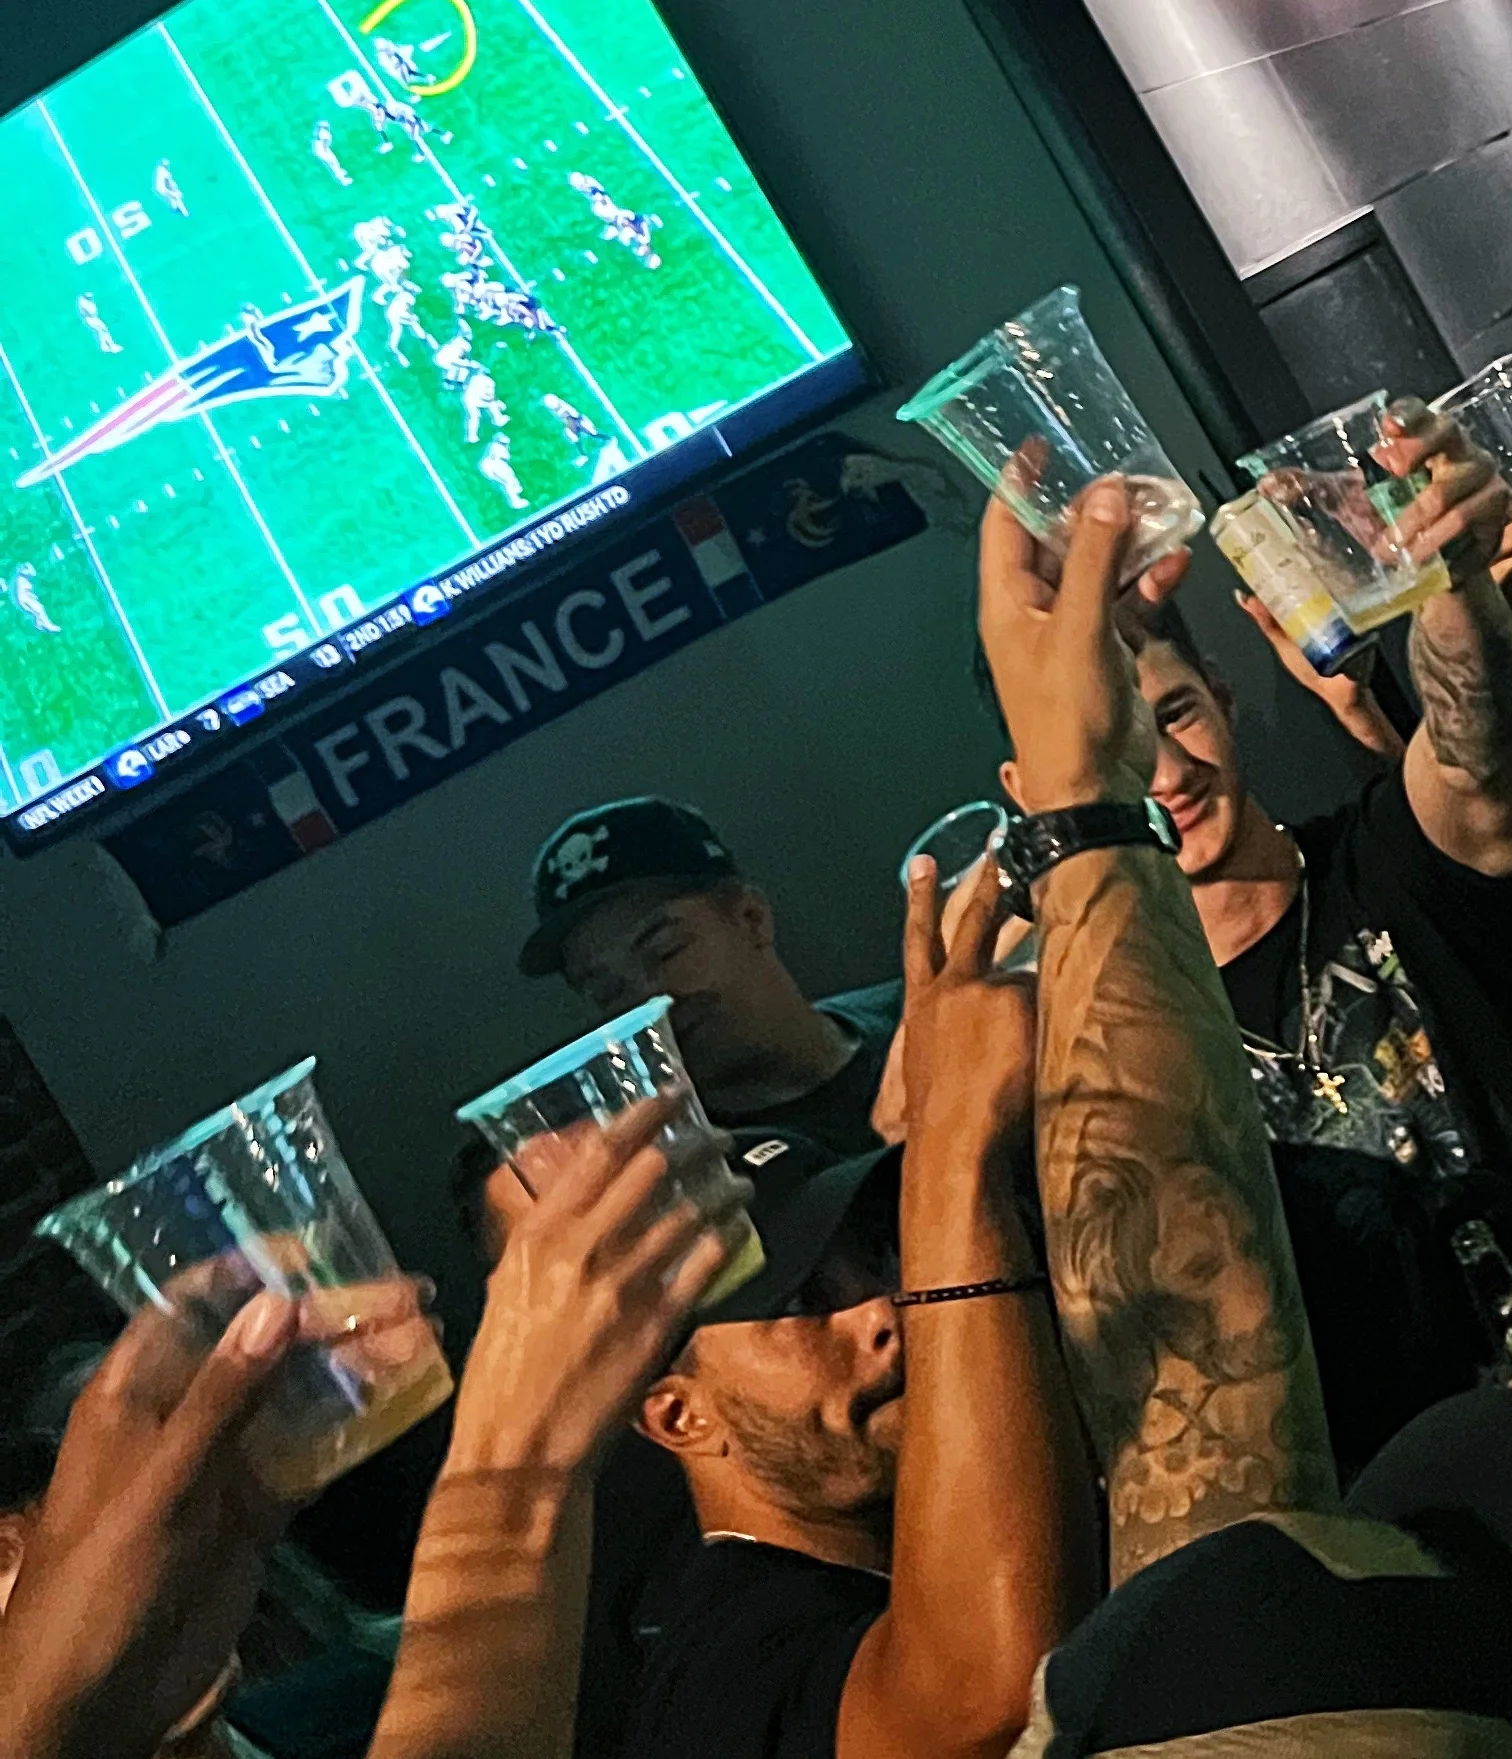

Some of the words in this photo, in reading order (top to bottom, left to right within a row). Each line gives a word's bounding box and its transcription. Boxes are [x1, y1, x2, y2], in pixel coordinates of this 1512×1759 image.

[254, 670, 296, 699] SEA
[346, 621, 382, 652] 2ND
[540, 520, 565, 545] YD
[560, 500, 609, 534] RUSH
[603, 485, 631, 509] TD
[313, 548, 693, 807] FRANCE
